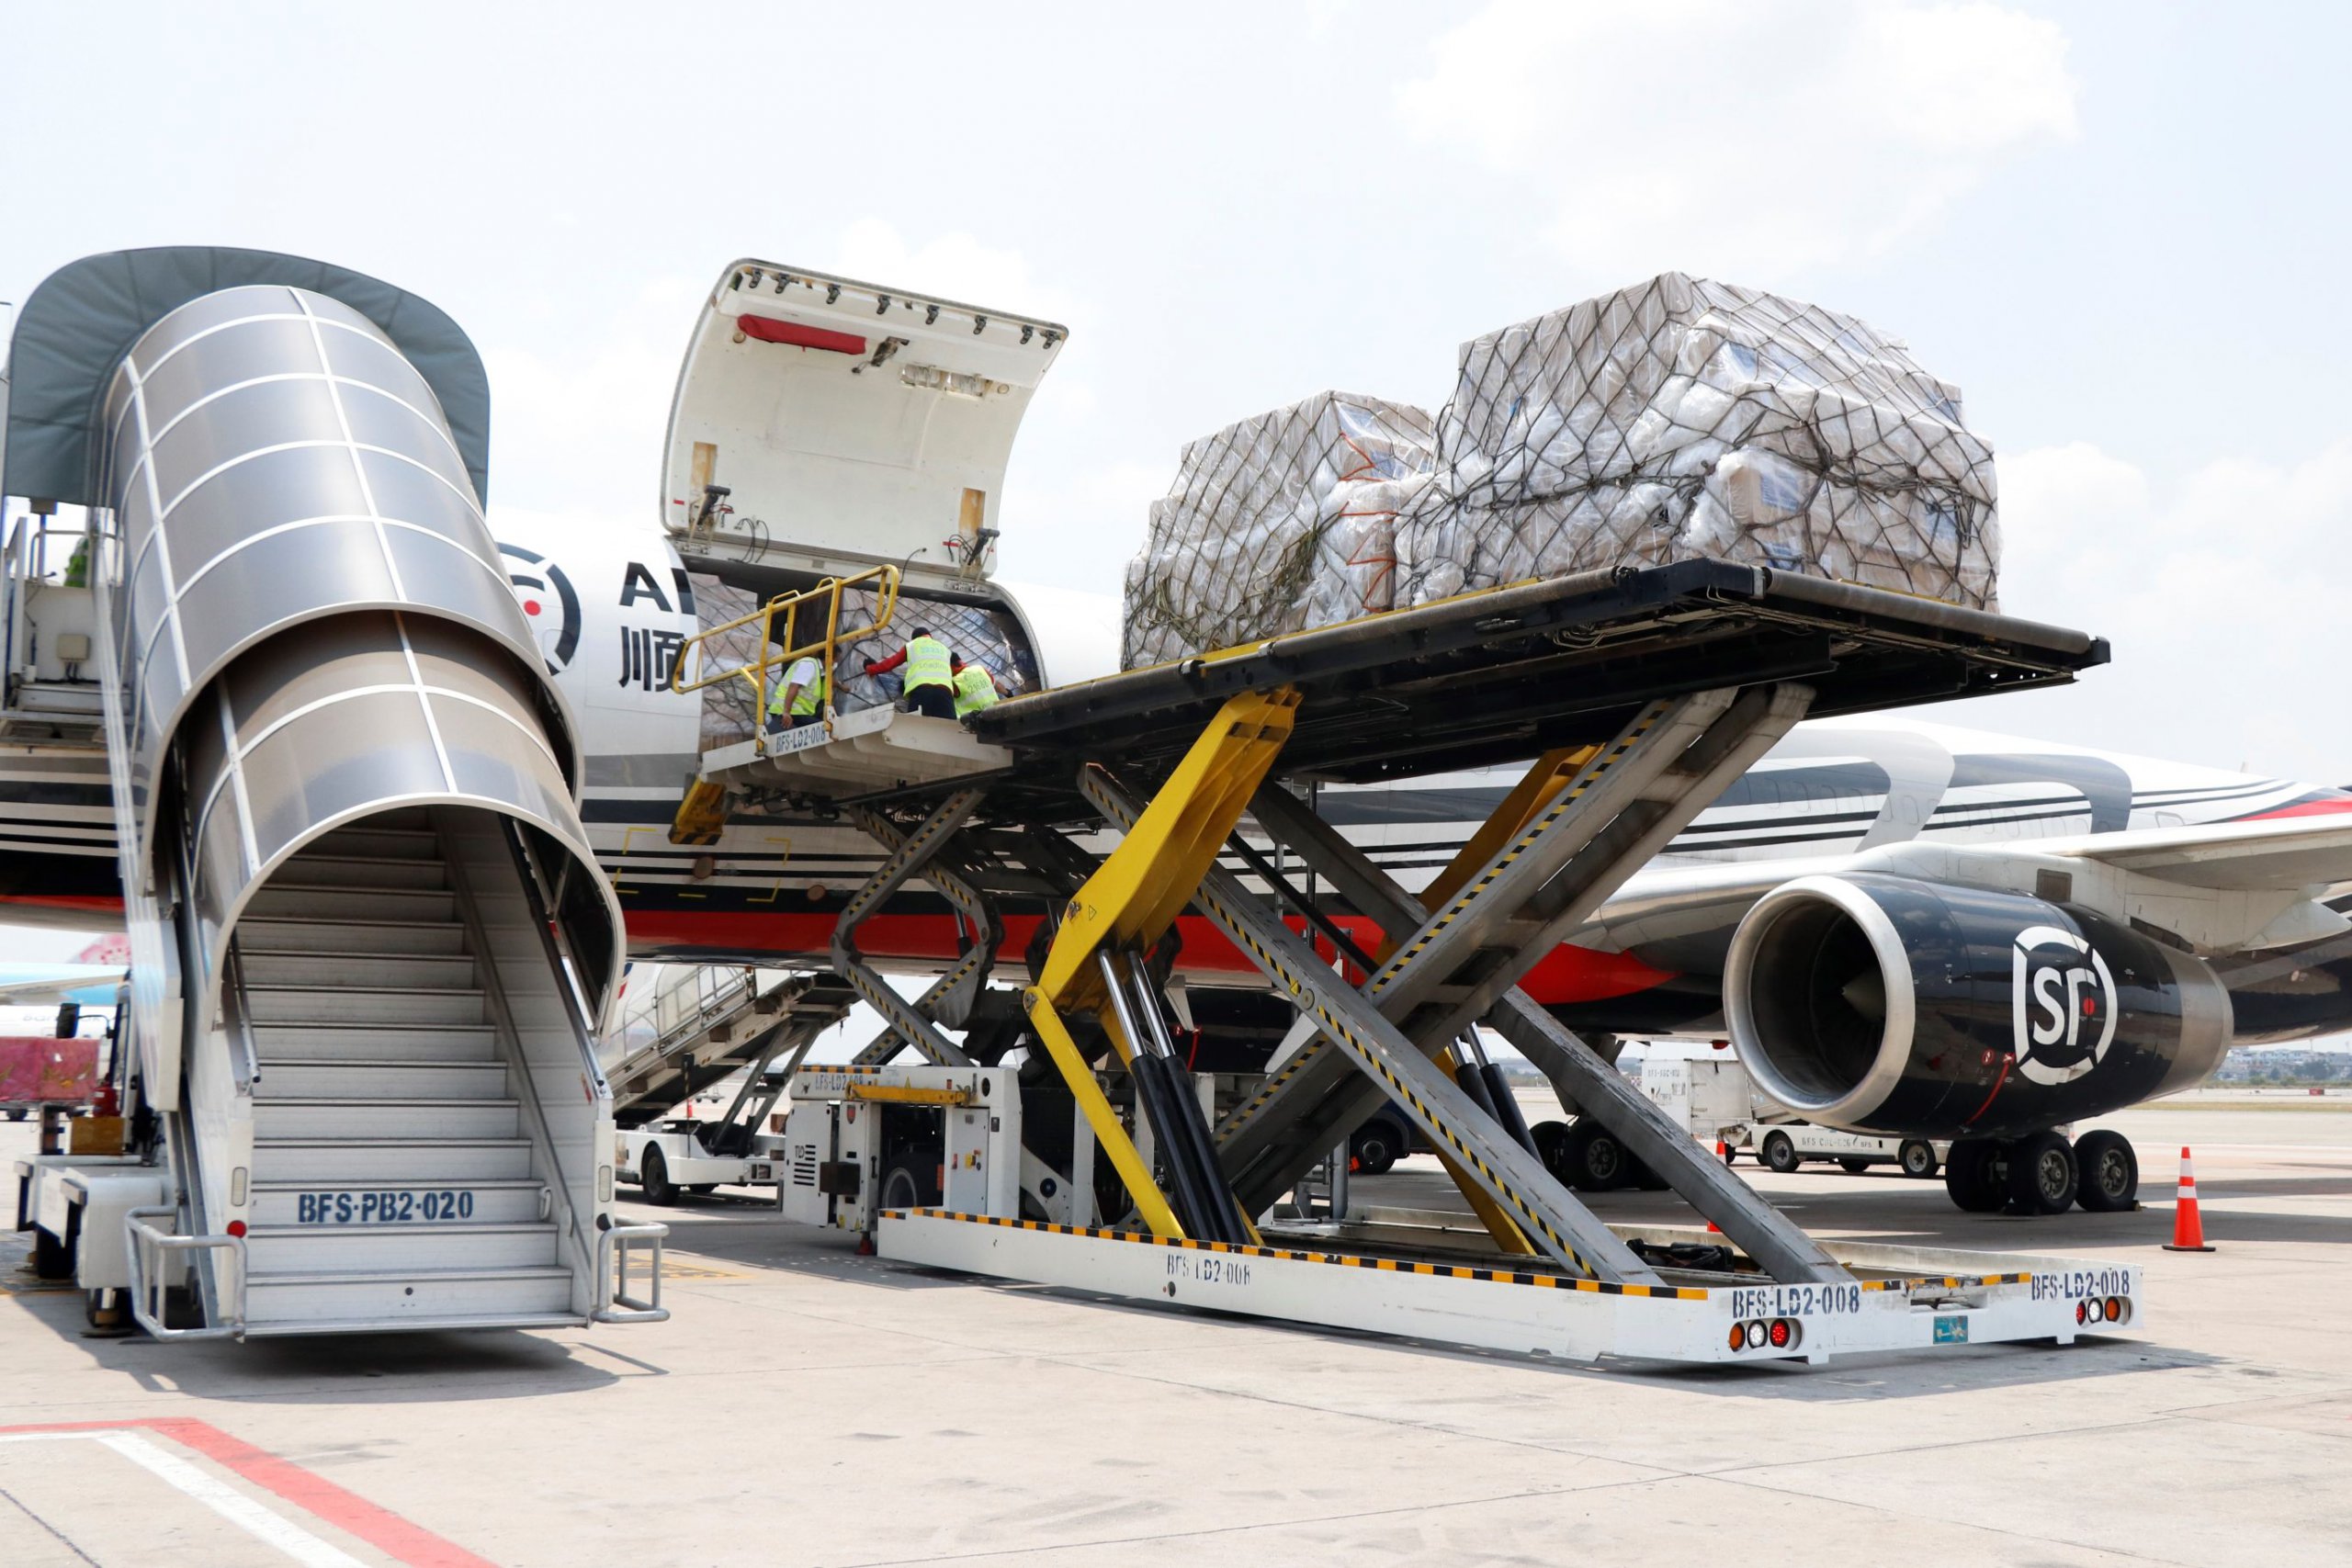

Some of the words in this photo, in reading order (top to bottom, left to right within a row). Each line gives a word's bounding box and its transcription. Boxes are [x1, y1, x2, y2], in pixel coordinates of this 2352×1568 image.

[298, 1190, 474, 1223] BFS-PB2-020
[1732, 1284, 1860, 1319] BFS-LD2-008
[2031, 1269, 2130, 1301] BFS-LD2-008
